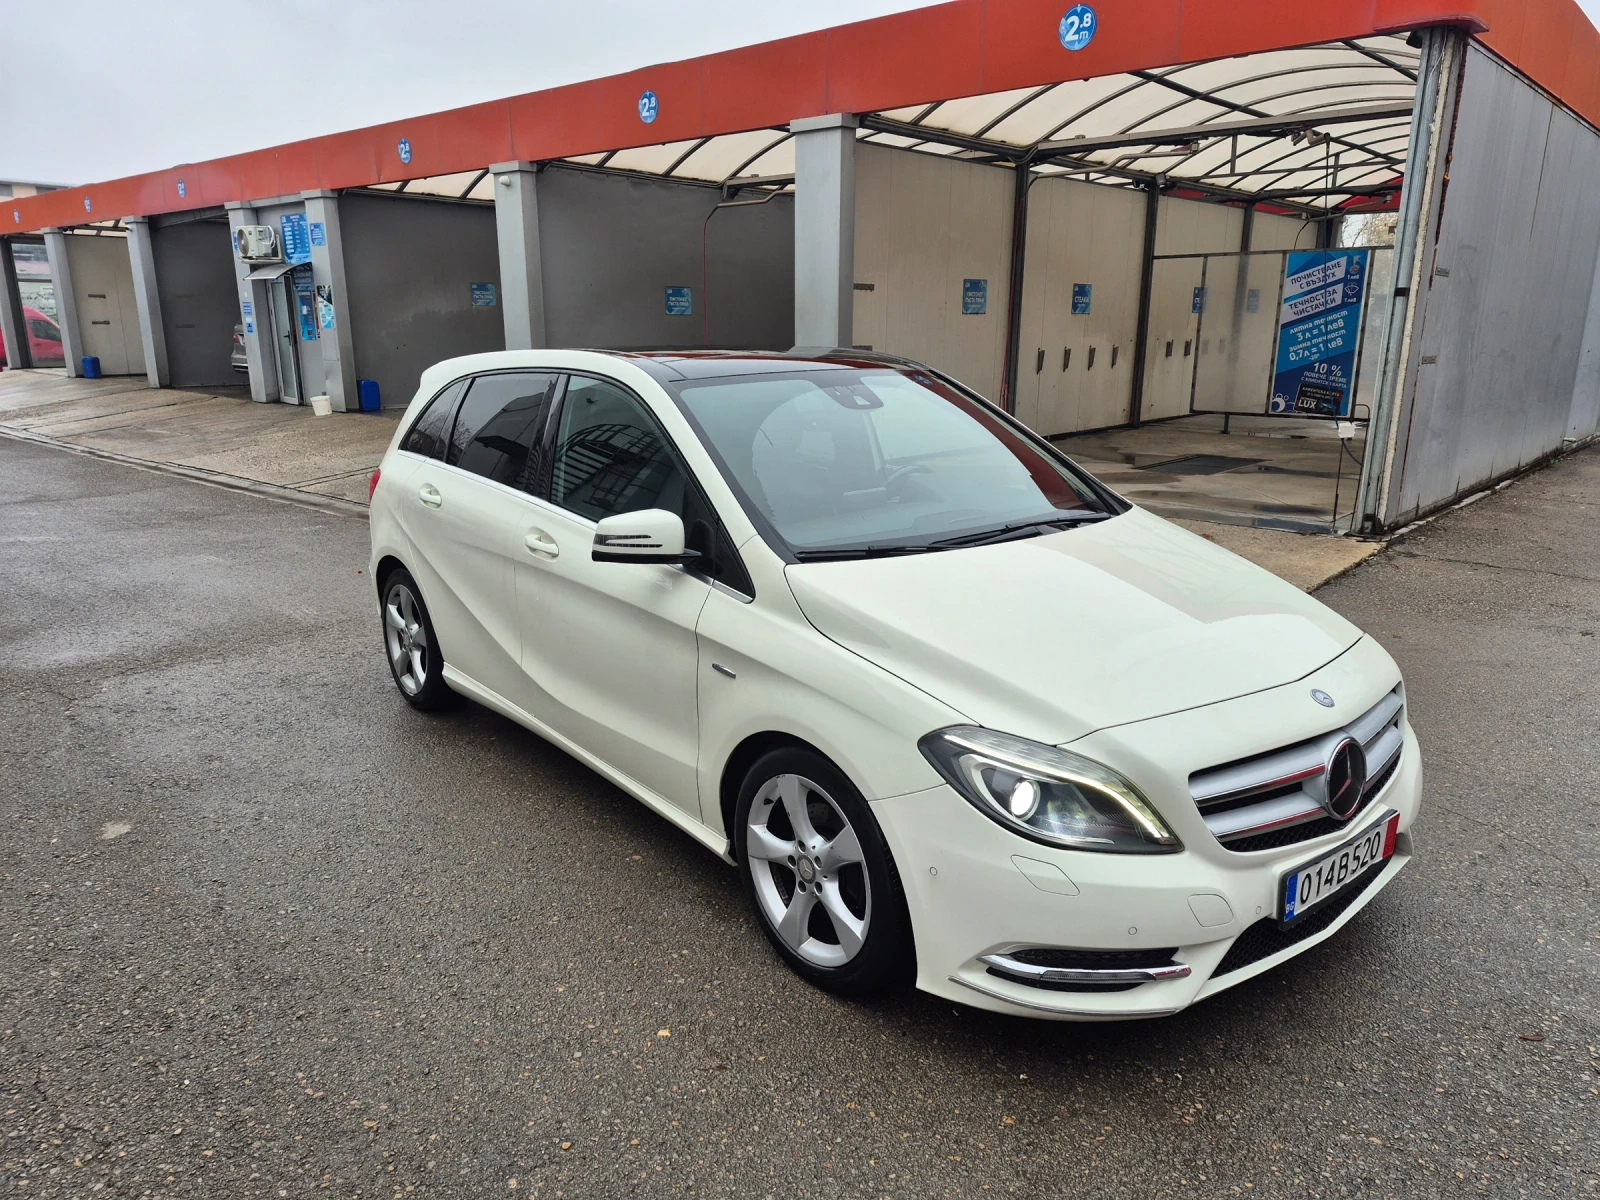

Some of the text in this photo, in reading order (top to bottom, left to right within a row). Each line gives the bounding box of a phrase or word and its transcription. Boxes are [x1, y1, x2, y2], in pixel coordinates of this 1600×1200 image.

[1065, 12, 1092, 42] 2.8
[1079, 30, 1089, 40] m
[641, 96, 656, 117] 2.8
[1290, 260, 1342, 285] ПОЧИСТВАНЕ
[1305, 271, 1337, 288] ВЪЗДУХ
[1288, 288, 1338, 310] ТЕЧНОСТ ЗА
[1293, 297, 1336, 317] ЧИСТАЧКИ
[1289, 322, 1313, 335] лятна
[1296, 332, 1304, 342] 3
[1305, 331, 1312, 339] л
[1320, 325, 1326, 333] 1
[1327, 318, 1345, 332] лев
[1318, 343, 1325, 352] 1
[1303, 371, 1328, 380] ПОВЕЧЕ
[1313, 362, 1342, 377] 10 %
[1298, 399, 1317, 409] LUX
[1300, 831, 1381, 905] 014B520
[1285, 901, 1295, 914] BG
